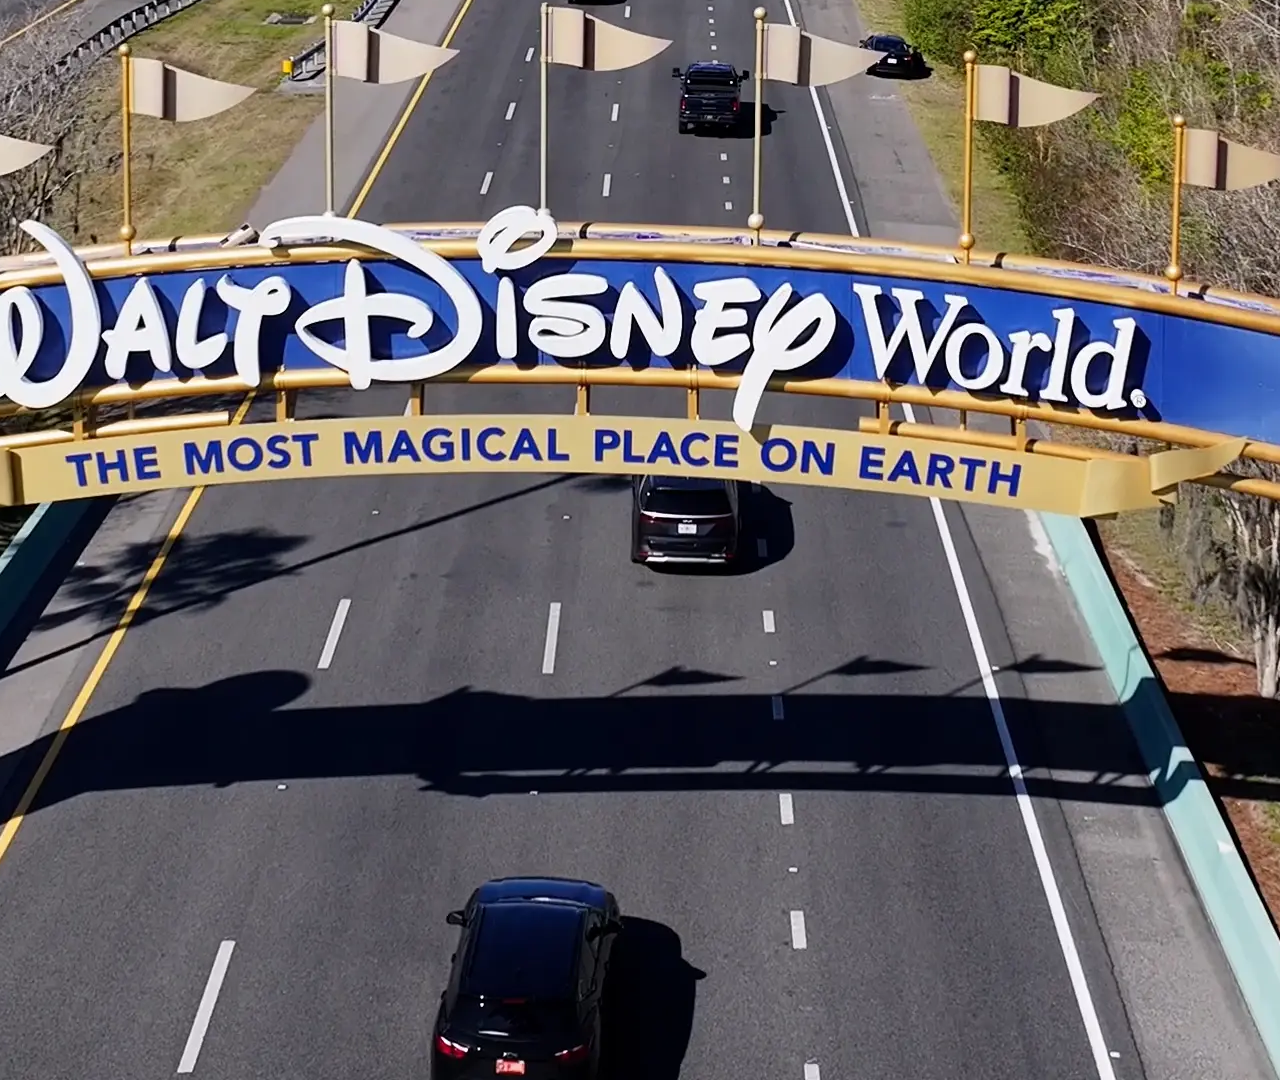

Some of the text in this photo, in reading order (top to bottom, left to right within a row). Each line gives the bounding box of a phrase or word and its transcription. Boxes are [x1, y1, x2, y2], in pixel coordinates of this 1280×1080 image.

[65, 426, 1023, 498] THE MOST MAGICAL PLACE ON EARTH
